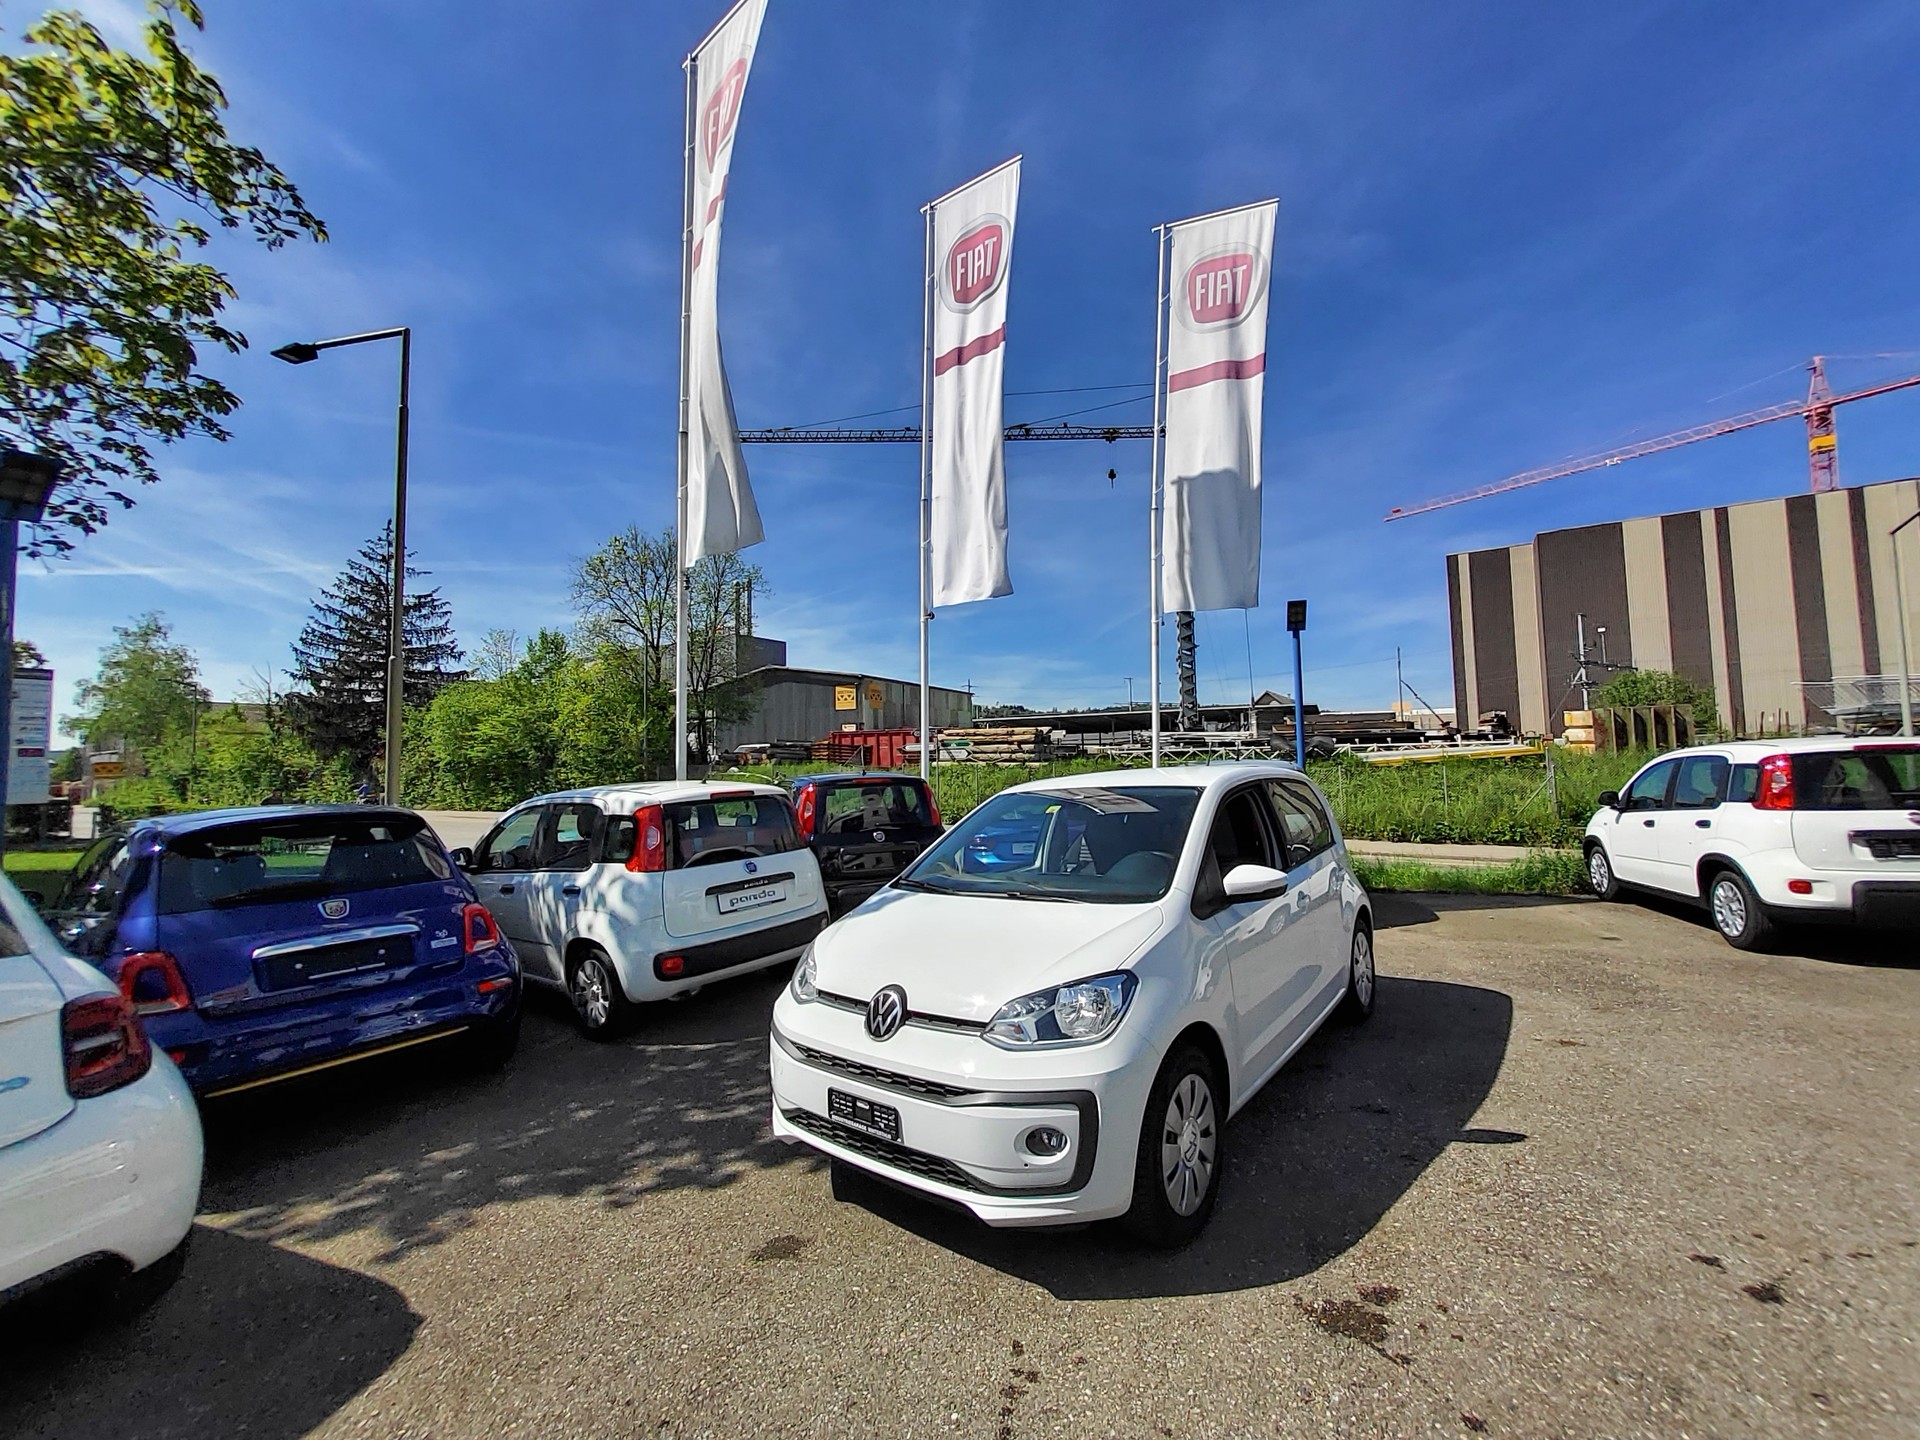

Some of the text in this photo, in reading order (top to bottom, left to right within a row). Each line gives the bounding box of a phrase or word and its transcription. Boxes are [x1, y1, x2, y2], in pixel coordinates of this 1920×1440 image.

[956, 236, 998, 292] FIAT
[1195, 264, 1248, 311] FIAT
[730, 890, 776, 907] panda
